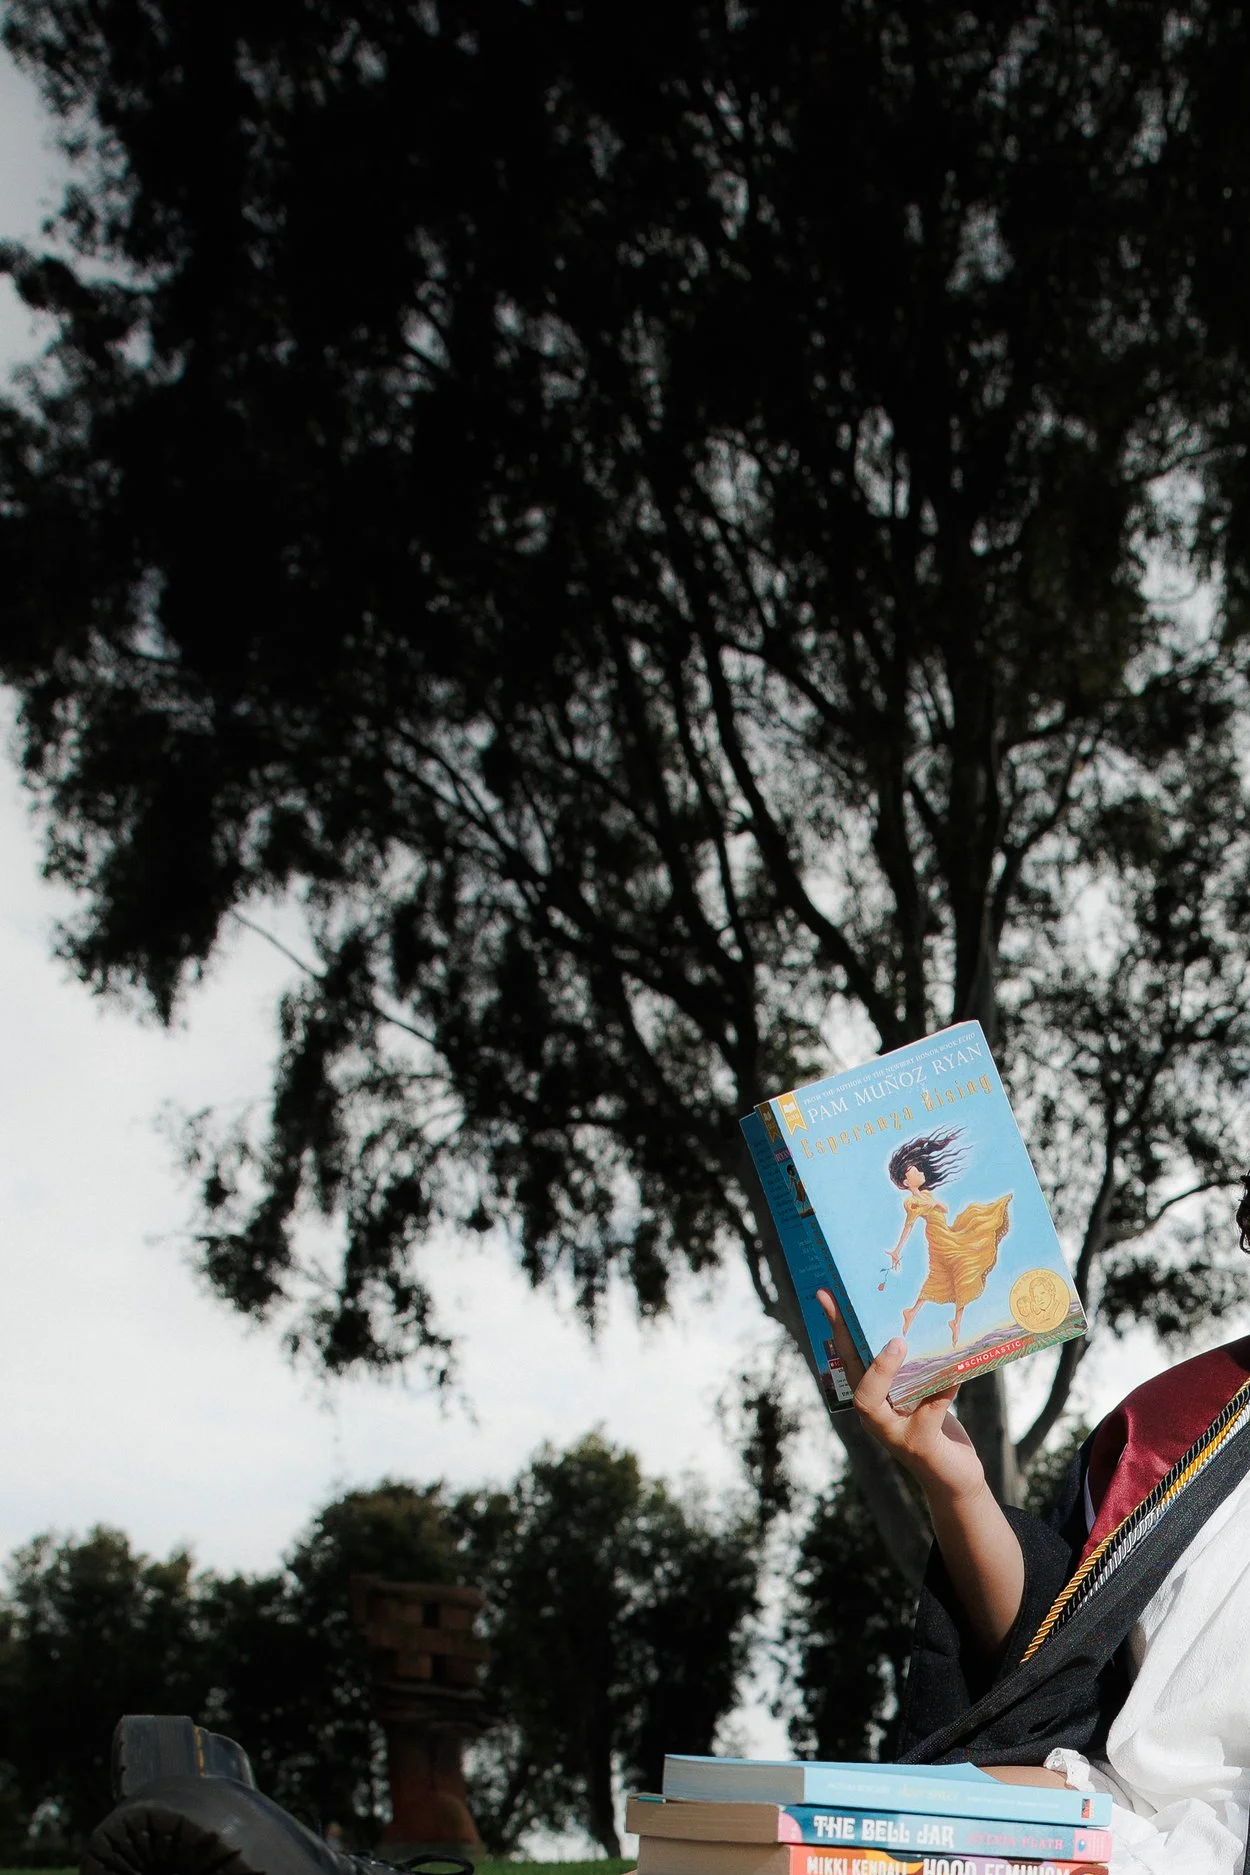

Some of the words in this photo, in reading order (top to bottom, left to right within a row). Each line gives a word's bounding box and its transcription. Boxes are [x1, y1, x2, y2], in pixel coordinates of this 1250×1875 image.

[957, 1032, 976, 1046] ECHO
[807, 1097, 849, 1124] PAM
[853, 1066, 928, 1106] MUÑOZ
[932, 1042, 983, 1076] RYAN
[800, 1104, 914, 1160] Esperanza
[920, 1072, 993, 1113] Rising
[963, 1340, 1022, 1369] SCHOLASTIC
[813, 1814, 855, 1840] THE
[861, 1819, 910, 1843] BELL
[917, 1825, 955, 1848] JAR
[967, 1832, 1018, 1848] SYLVIA
[1021, 1836, 1065, 1851] PLATH
